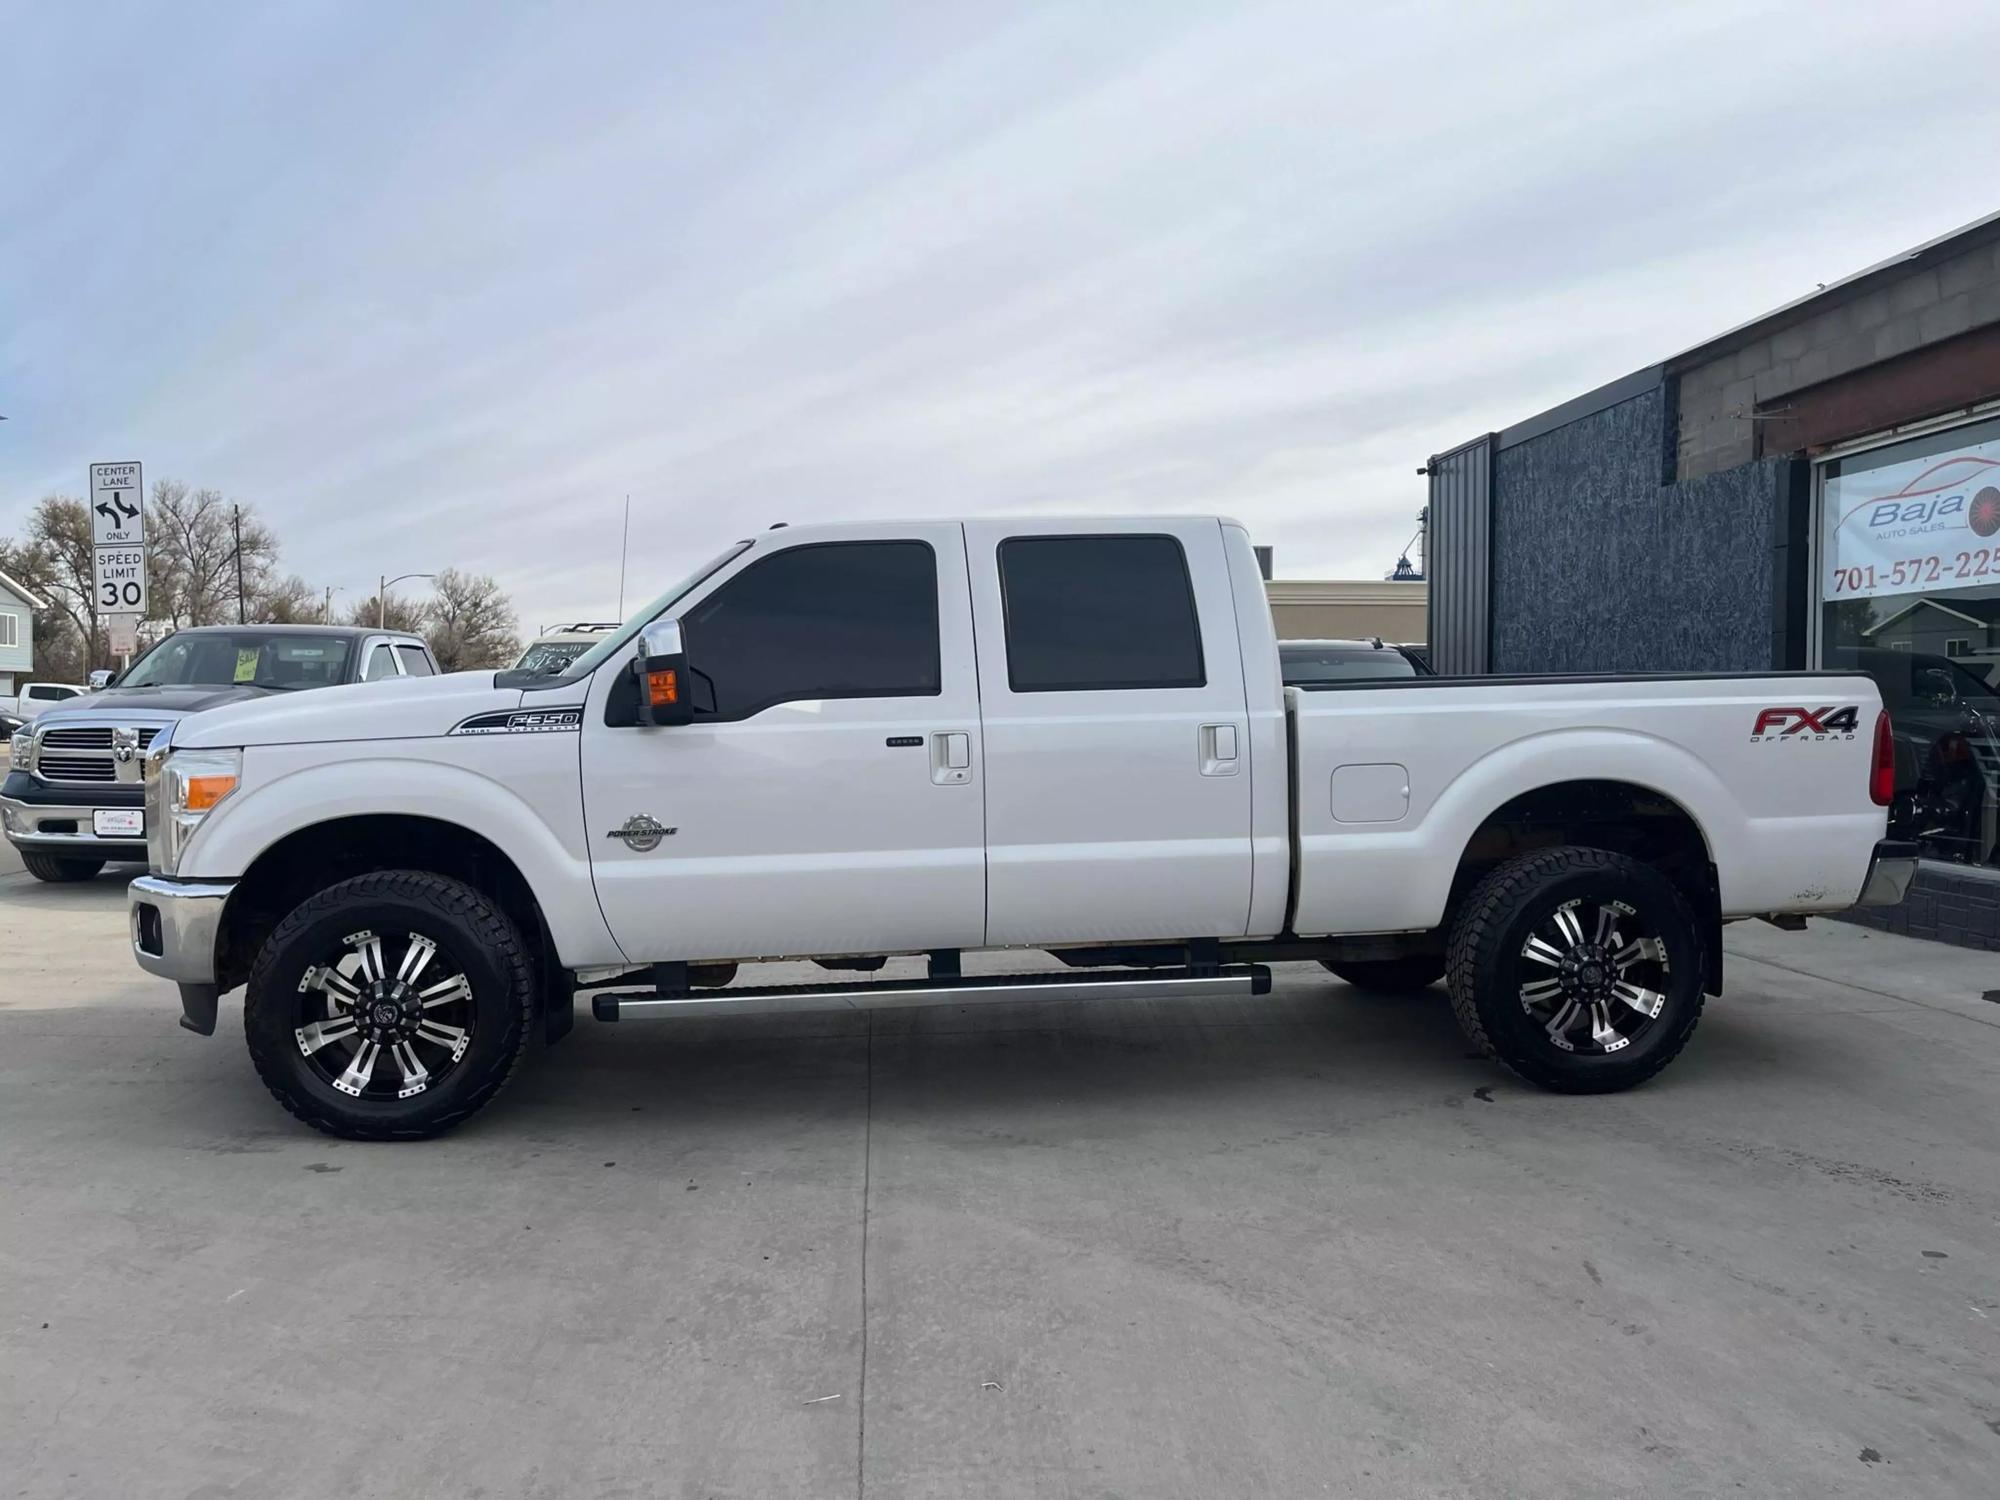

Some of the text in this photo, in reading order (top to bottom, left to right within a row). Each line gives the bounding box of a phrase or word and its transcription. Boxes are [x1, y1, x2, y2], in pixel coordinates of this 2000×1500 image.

[97, 466, 135, 477] CENTER
[103, 476, 130, 487] LANE
[1868, 494, 1965, 528] Baja
[106, 531, 131, 541] ONLY
[1876, 521, 1945, 541] AUTO SALES
[98, 553, 142, 565] SPEED
[103, 567, 137, 579] LIMIT
[101, 581, 142, 607] 30
[1751, 705, 1859, 736] FX4
[1750, 734, 1855, 743] OFF ROAD
[606, 827, 679, 839] POWER STROKE
